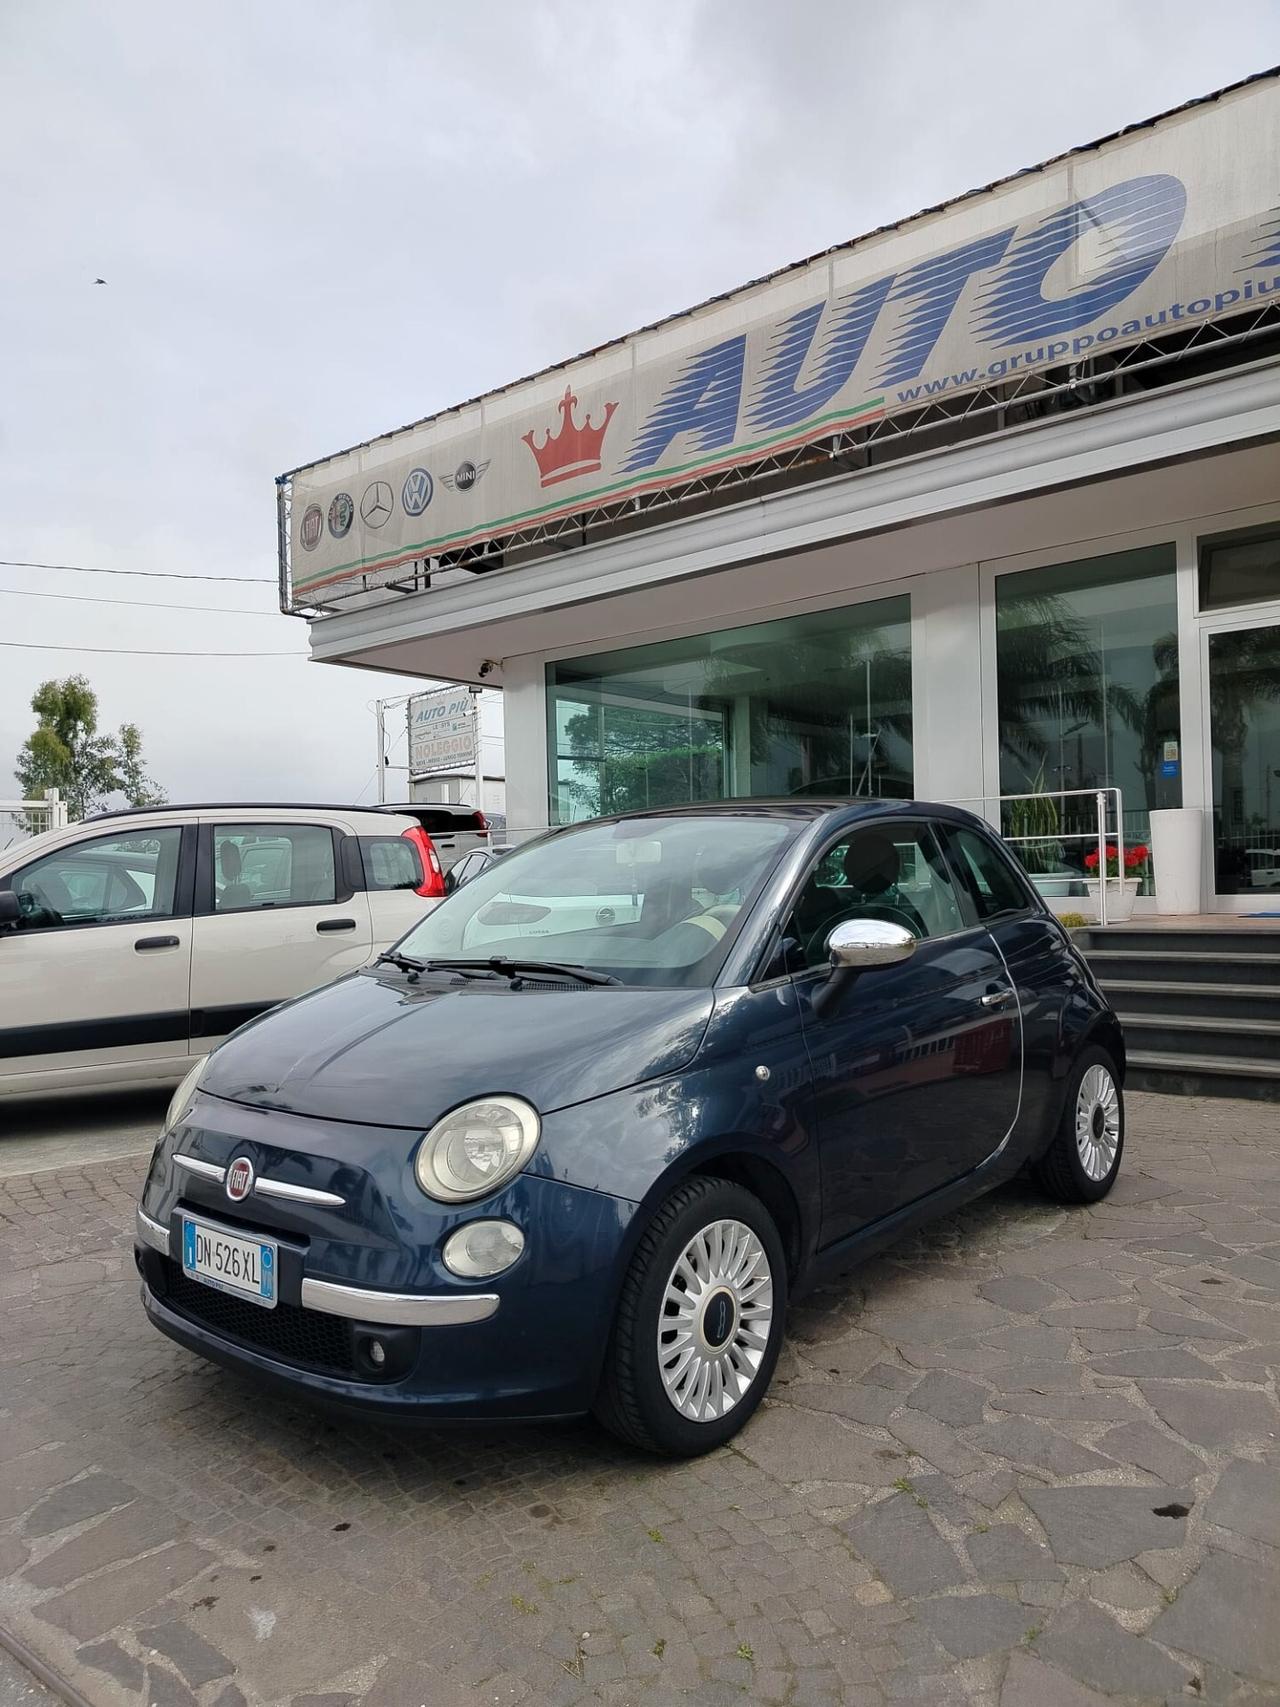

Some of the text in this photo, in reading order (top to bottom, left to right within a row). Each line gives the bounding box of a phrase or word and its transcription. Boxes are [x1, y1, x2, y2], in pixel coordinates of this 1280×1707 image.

[611, 173, 1187, 476] AUTO
[456, 470, 476, 484] MINI
[416, 706, 446, 723] AUTO
[415, 735, 472, 760] NOLEGGIO
[231, 1169, 248, 1190] FIAT
